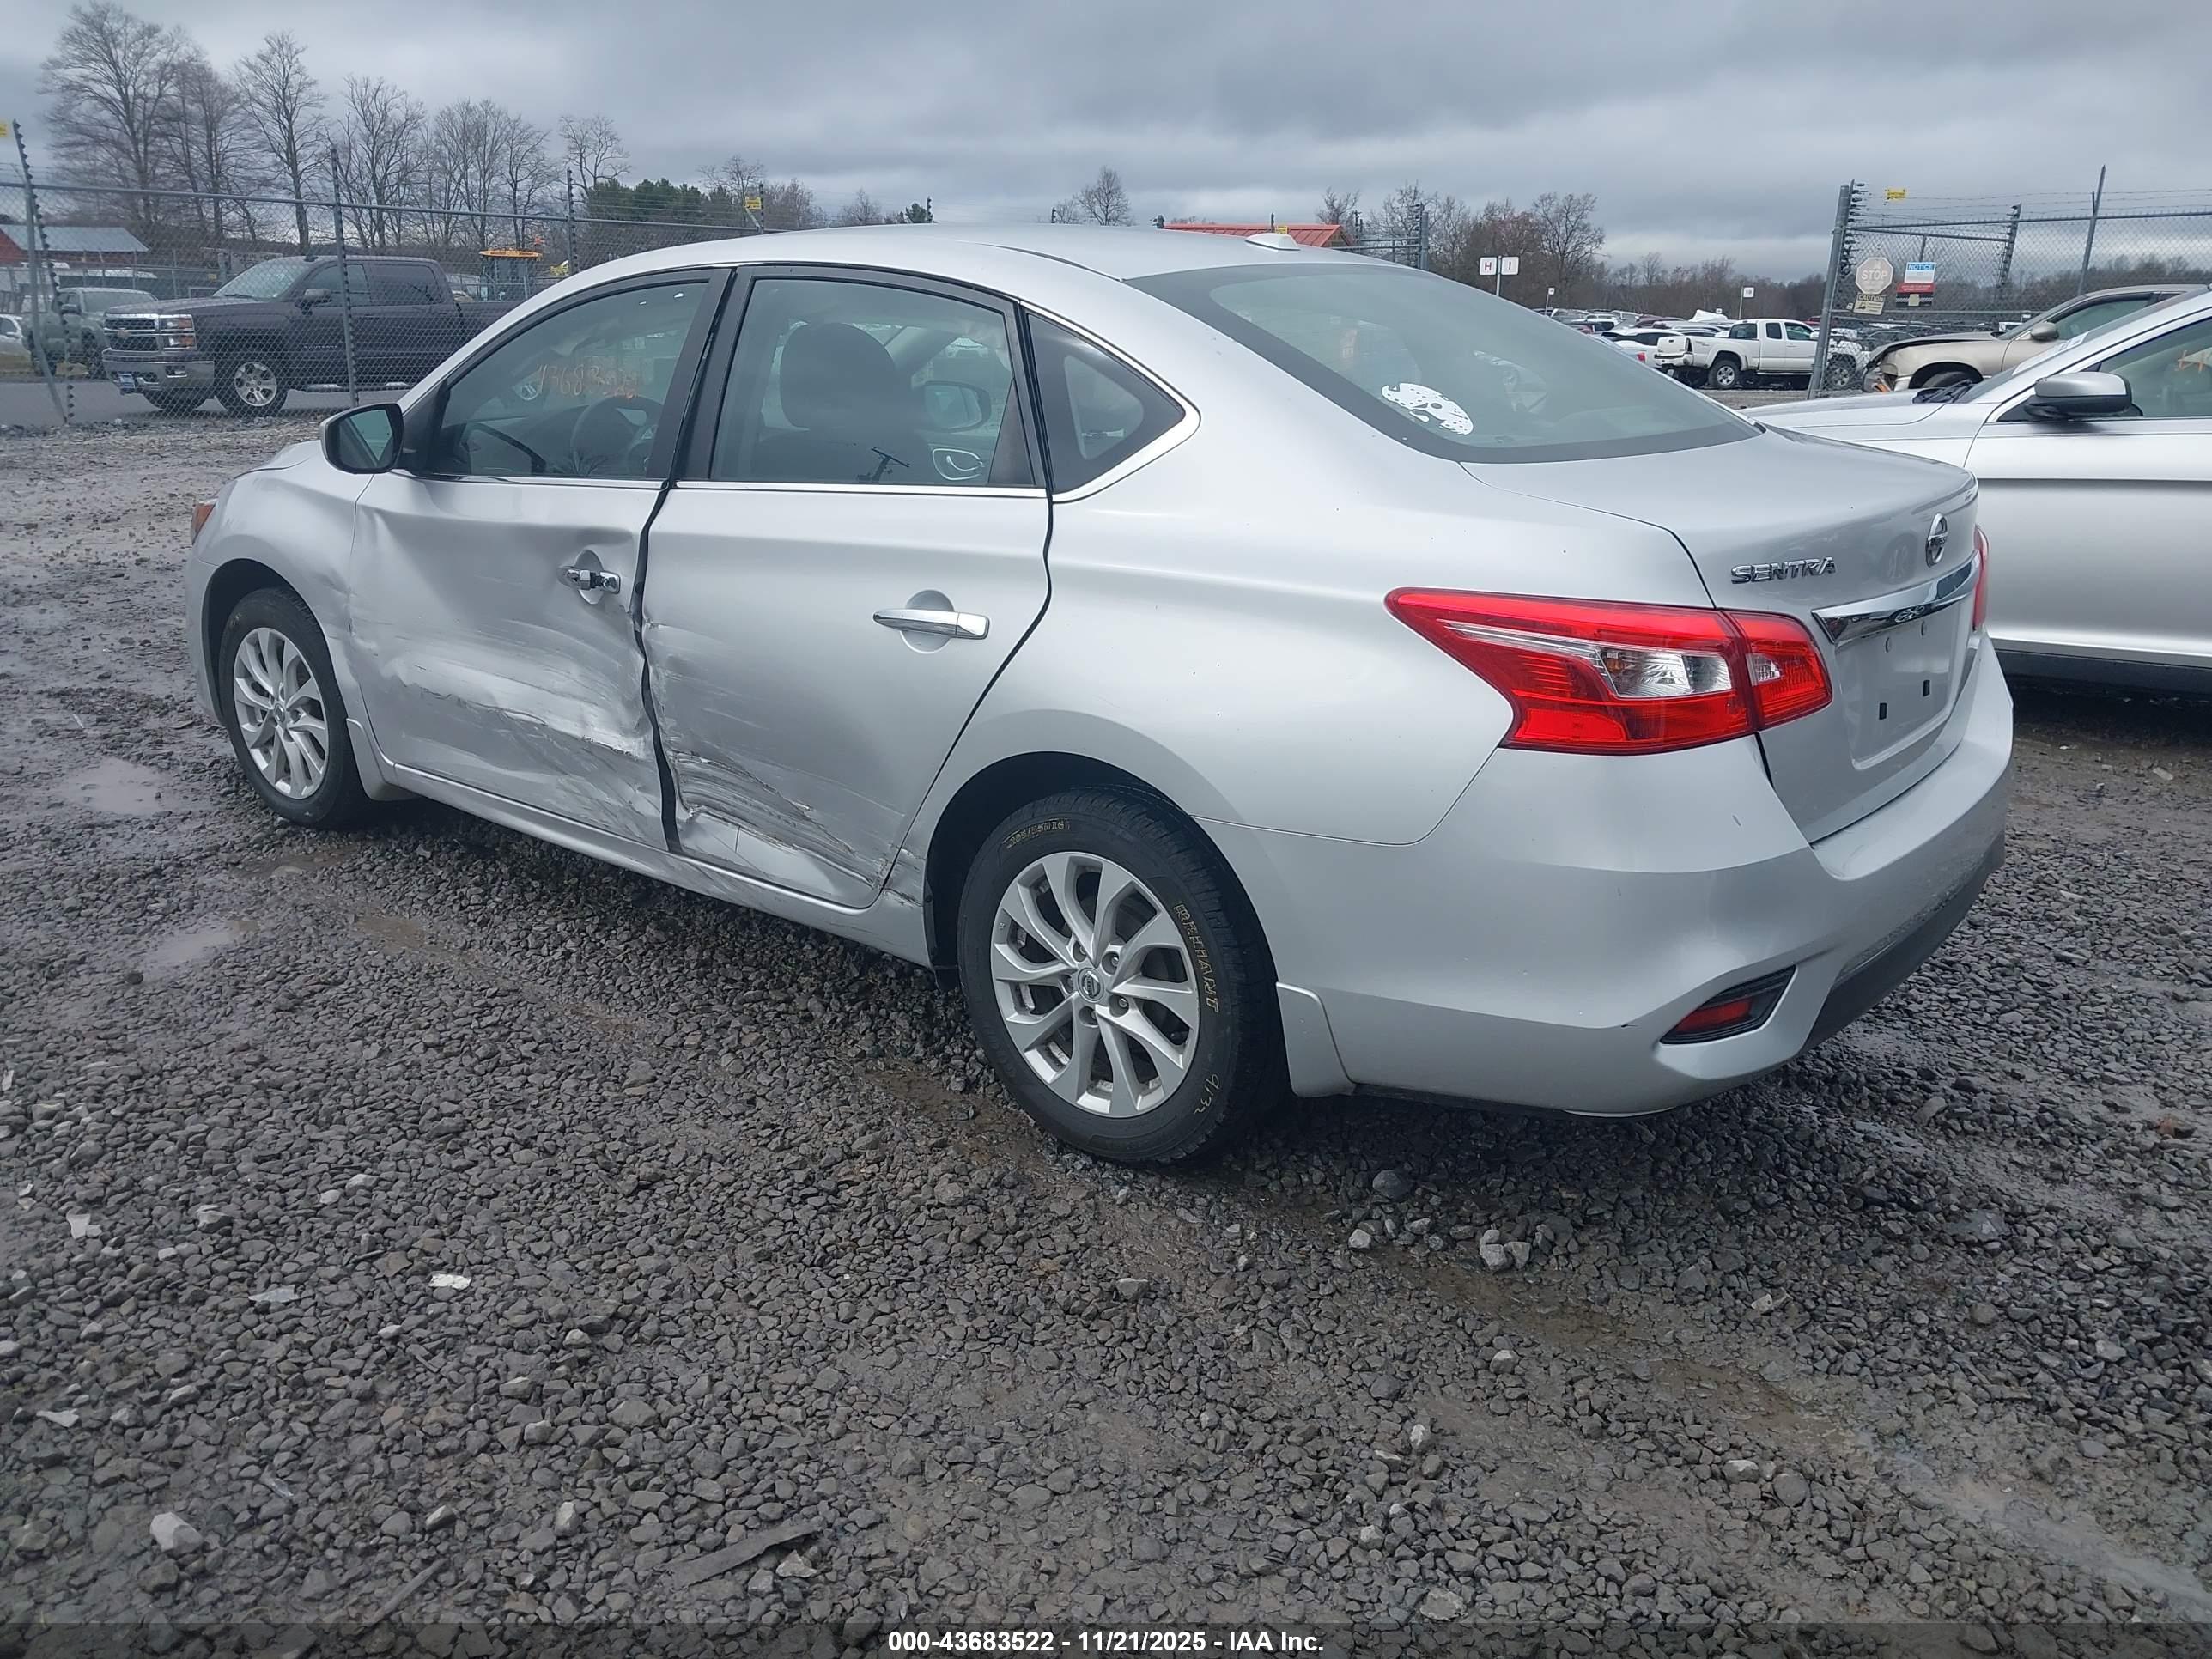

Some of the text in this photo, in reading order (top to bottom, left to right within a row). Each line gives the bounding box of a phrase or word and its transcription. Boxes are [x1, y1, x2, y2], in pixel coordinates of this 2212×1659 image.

[1484, 261, 1492, 270] H
[1861, 270, 1887, 280] STOP
[1858, 294, 1884, 302] CAUTION
[1731, 556, 1837, 584] SENTRA
